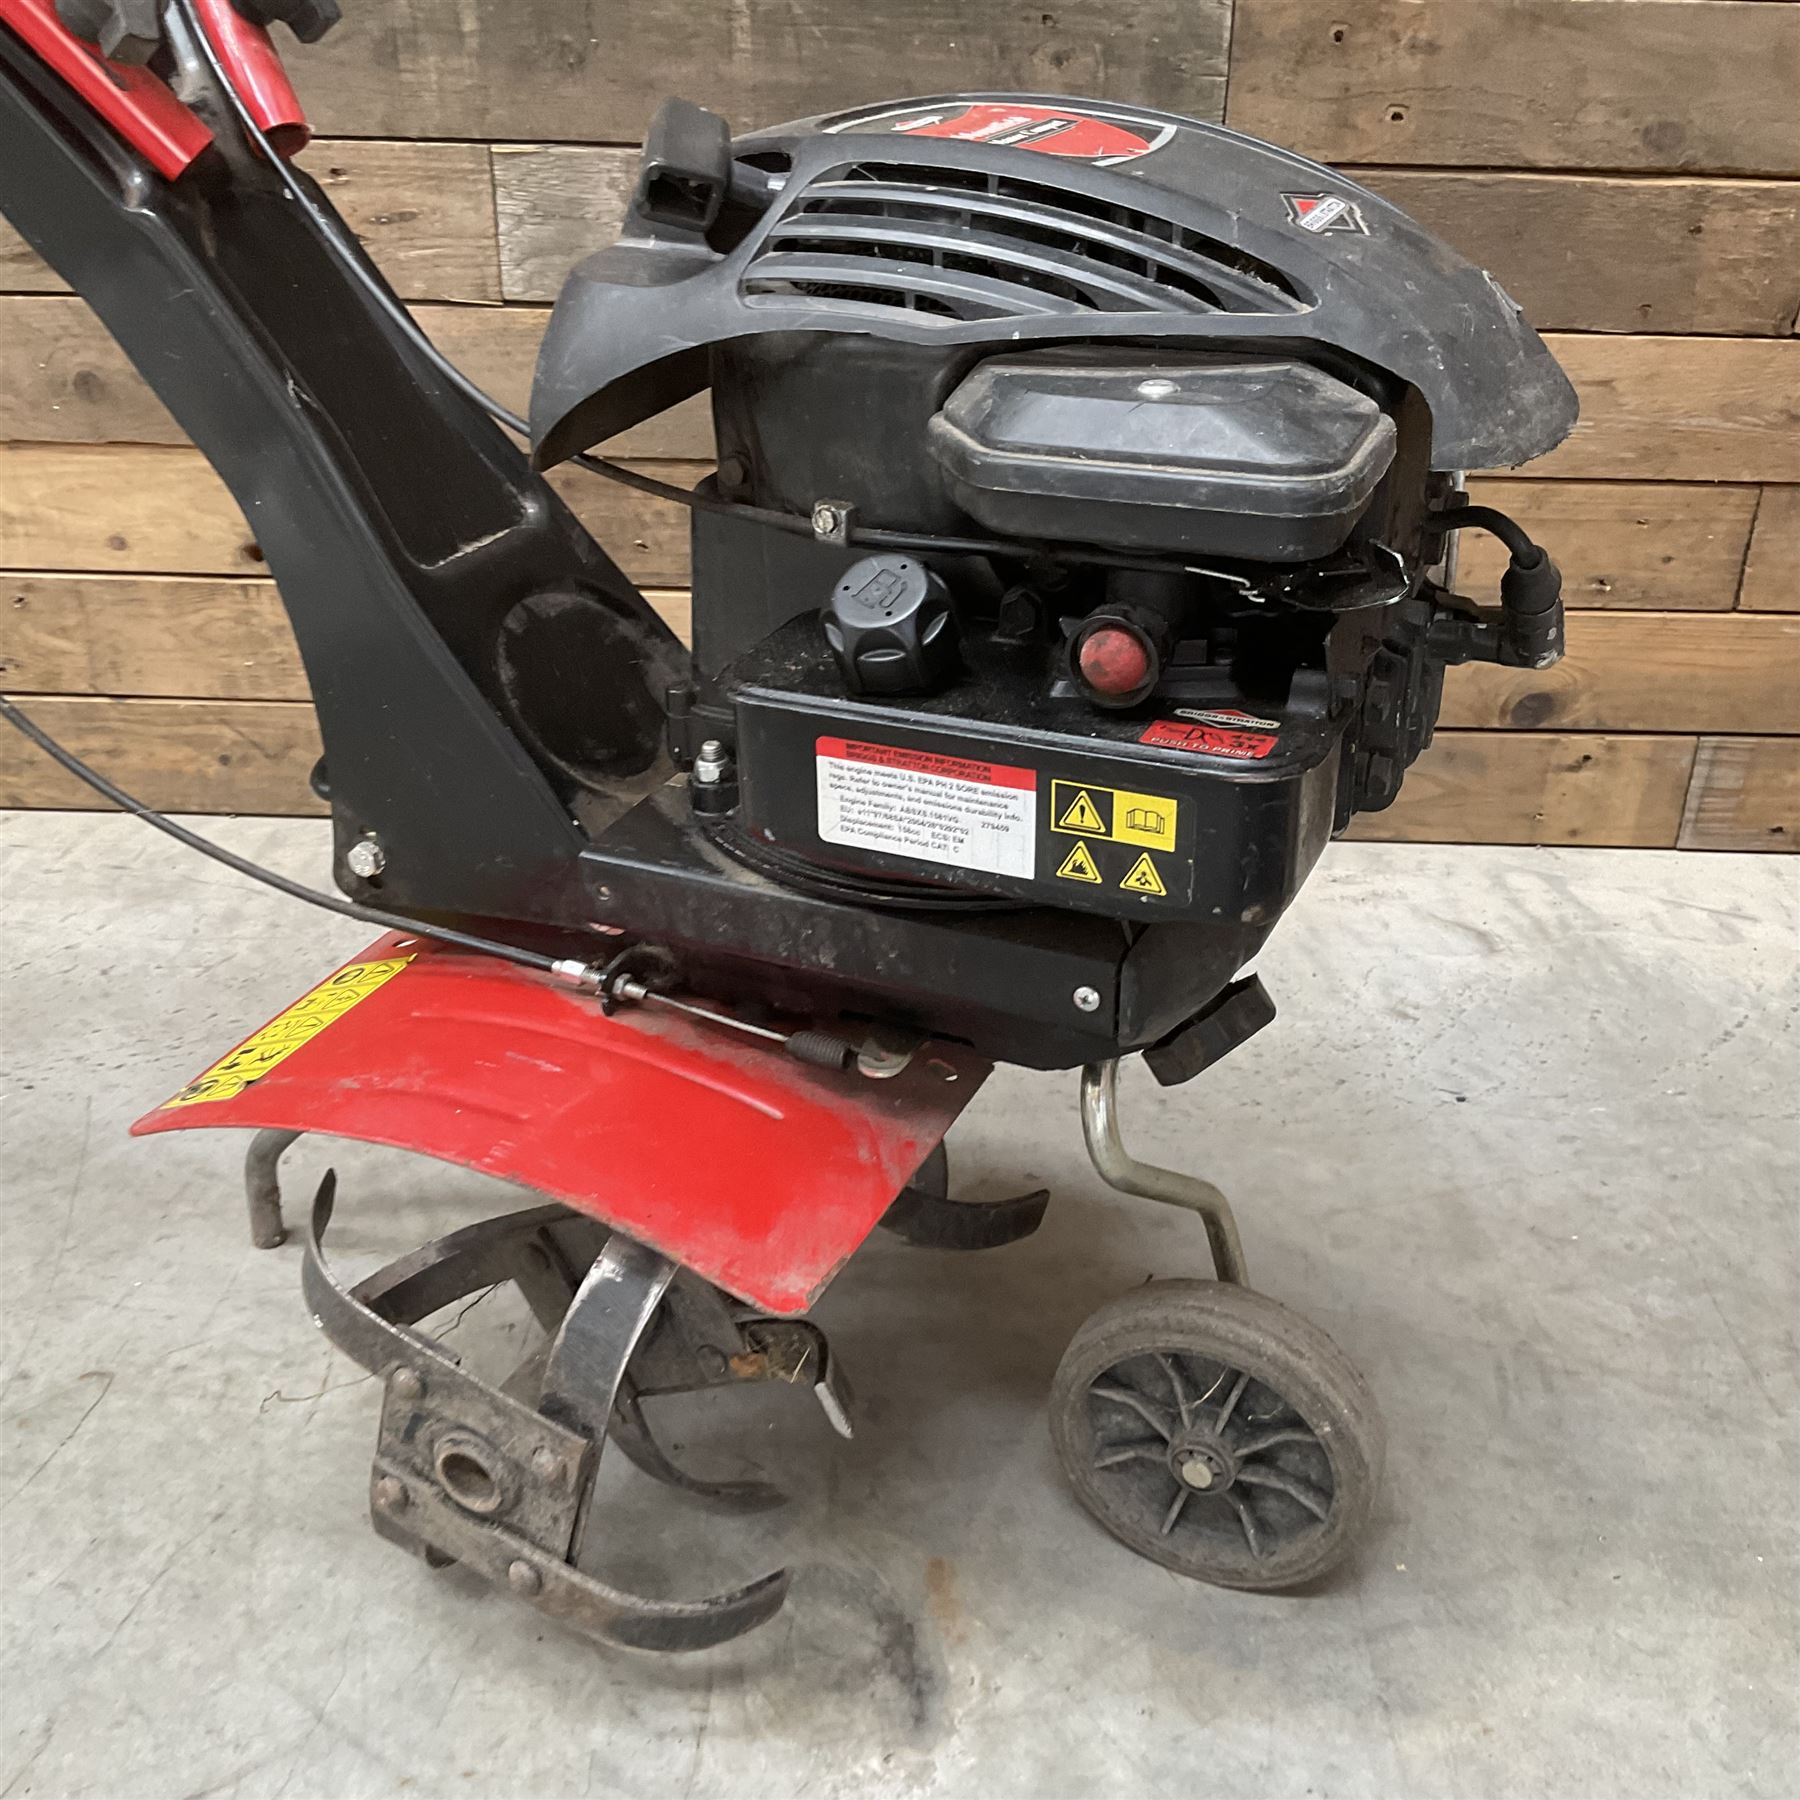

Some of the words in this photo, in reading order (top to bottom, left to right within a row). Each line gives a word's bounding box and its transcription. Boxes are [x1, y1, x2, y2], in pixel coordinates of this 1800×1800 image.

[845, 743, 891, 757] IMPORTANT
[893, 749, 933, 763] EMISSION
[934, 756, 992, 773] INFORMATION
[1151, 737, 1188, 747] PUSH
[1191, 742, 1210, 751] TO
[1211, 745, 1255, 757] PRIME
[845, 750, 878, 762] BRIGGS
[885, 757, 930, 770] STRATTON
[930, 764, 992, 782] CORPORATION
[828, 760, 844, 770] This
[846, 764, 872, 777] engine
[874, 770, 897, 779] meets
[917, 775, 933, 785] EPA
[980, 787, 1018, 800] emission
[839, 793, 866, 808] Engine
[906, 794, 921, 804] and
[922, 797, 962, 811] emissions
[914, 786, 942, 798] manual
[943, 791, 954, 799] for
[956, 793, 1008, 810] maintenance
[840, 823, 855, 834] EPA
[856, 826, 901, 844] Compliance
[902, 835, 928, 848] Period
